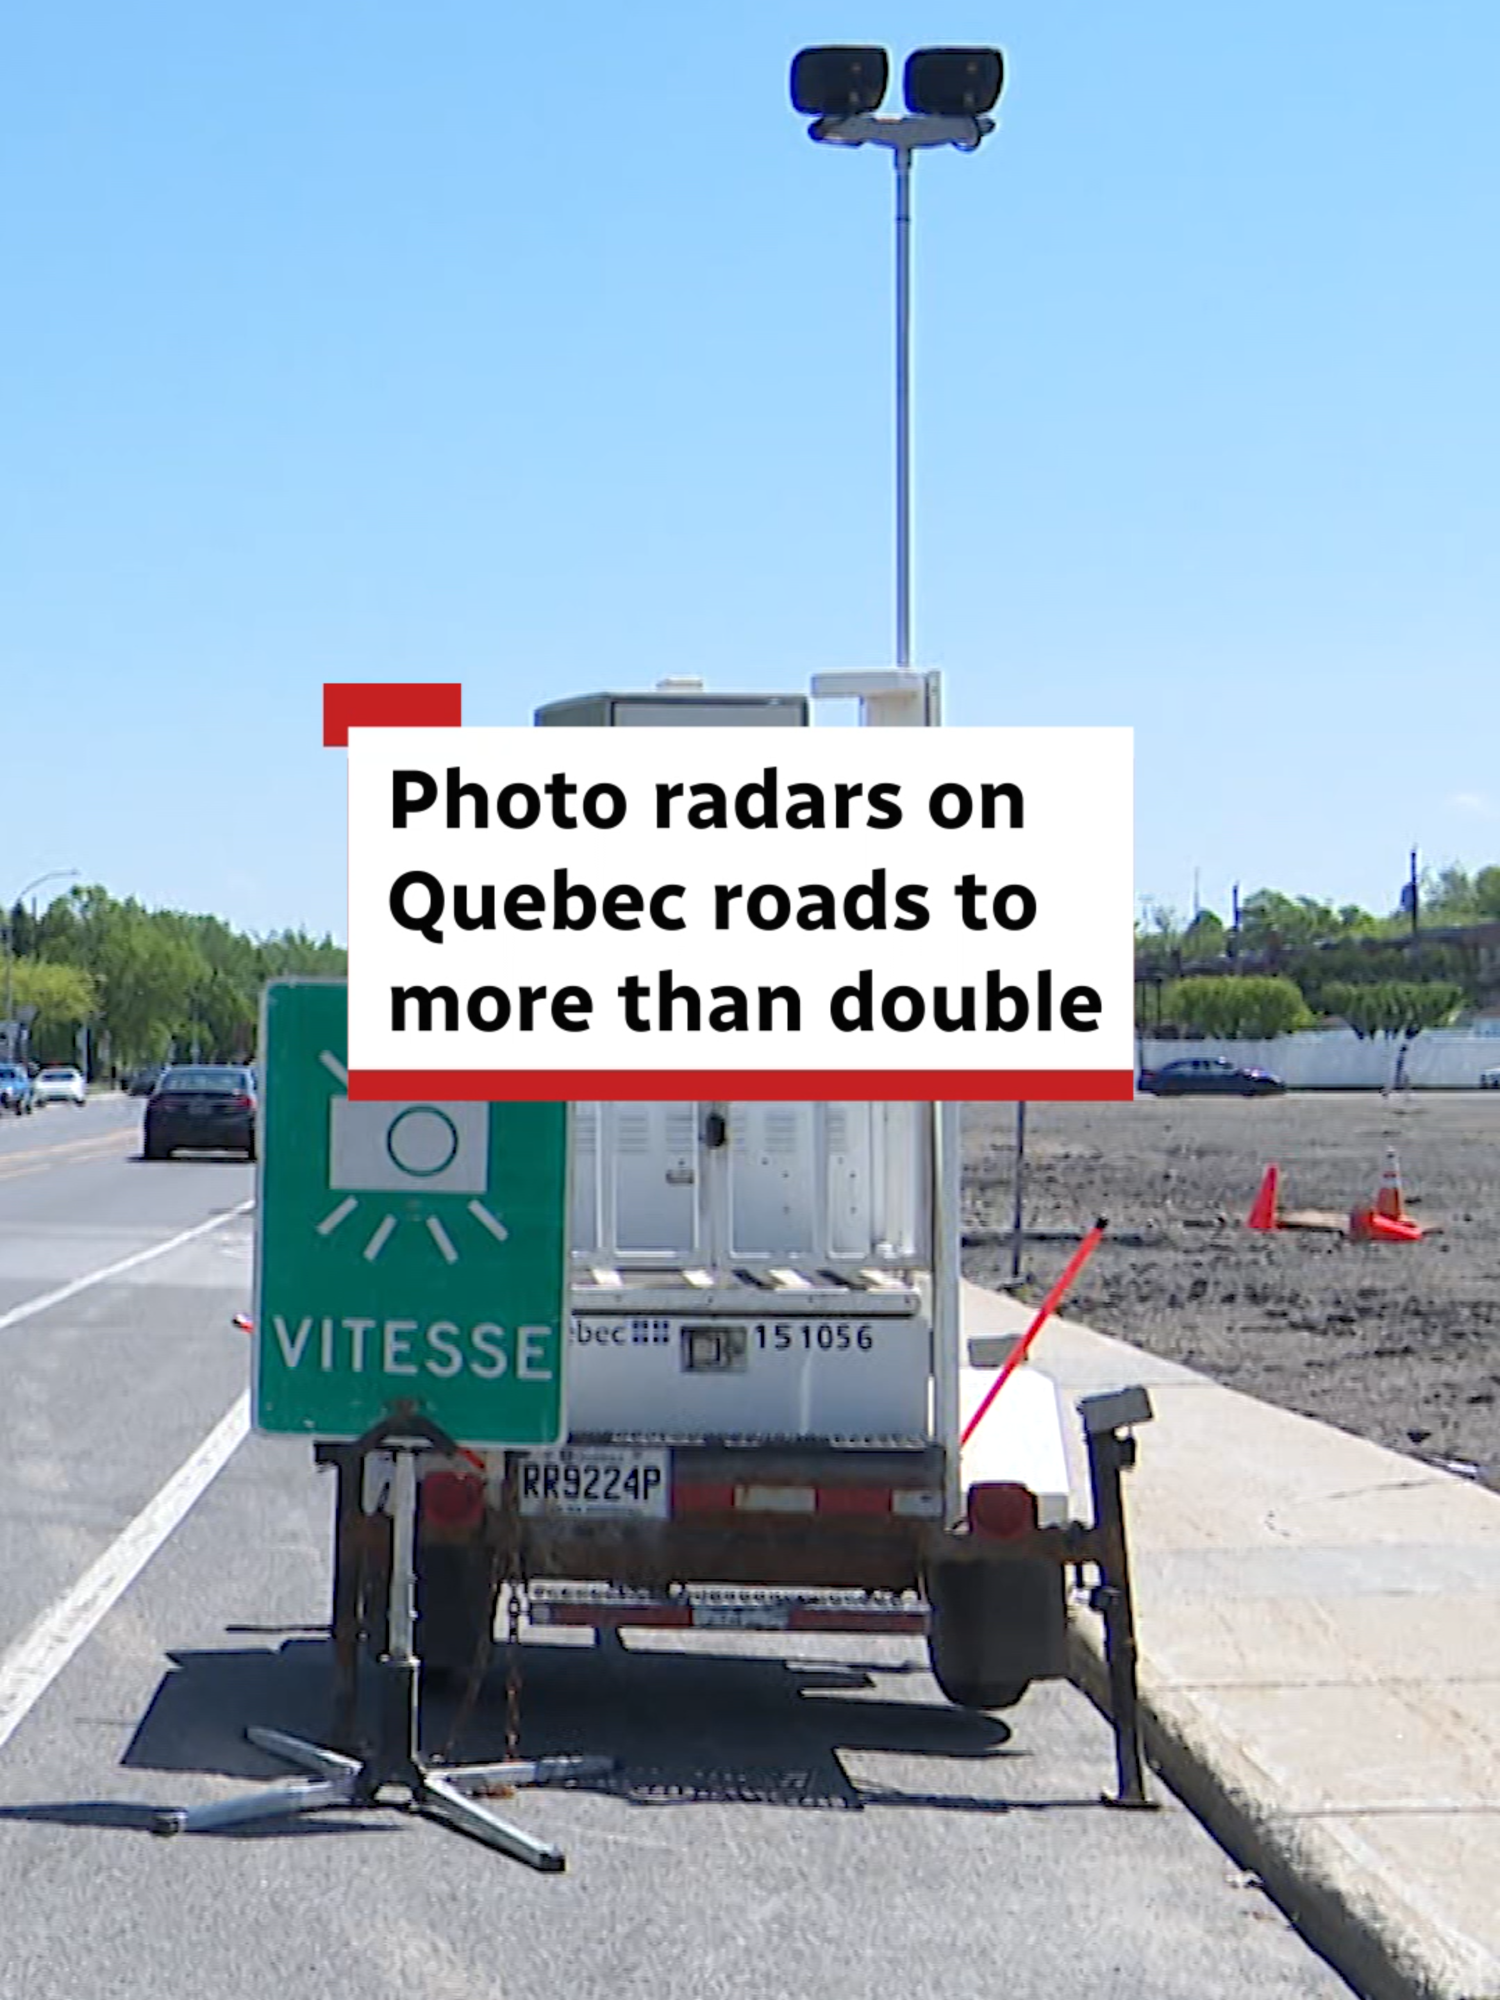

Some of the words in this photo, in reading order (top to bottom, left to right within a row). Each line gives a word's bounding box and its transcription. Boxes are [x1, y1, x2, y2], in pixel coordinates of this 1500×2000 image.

[570, 1320, 626, 1345] bec
[755, 1324, 873, 1350] 151056
[273, 1317, 553, 1381] VITESSE
[523, 1465, 661, 1500] RR9224P
